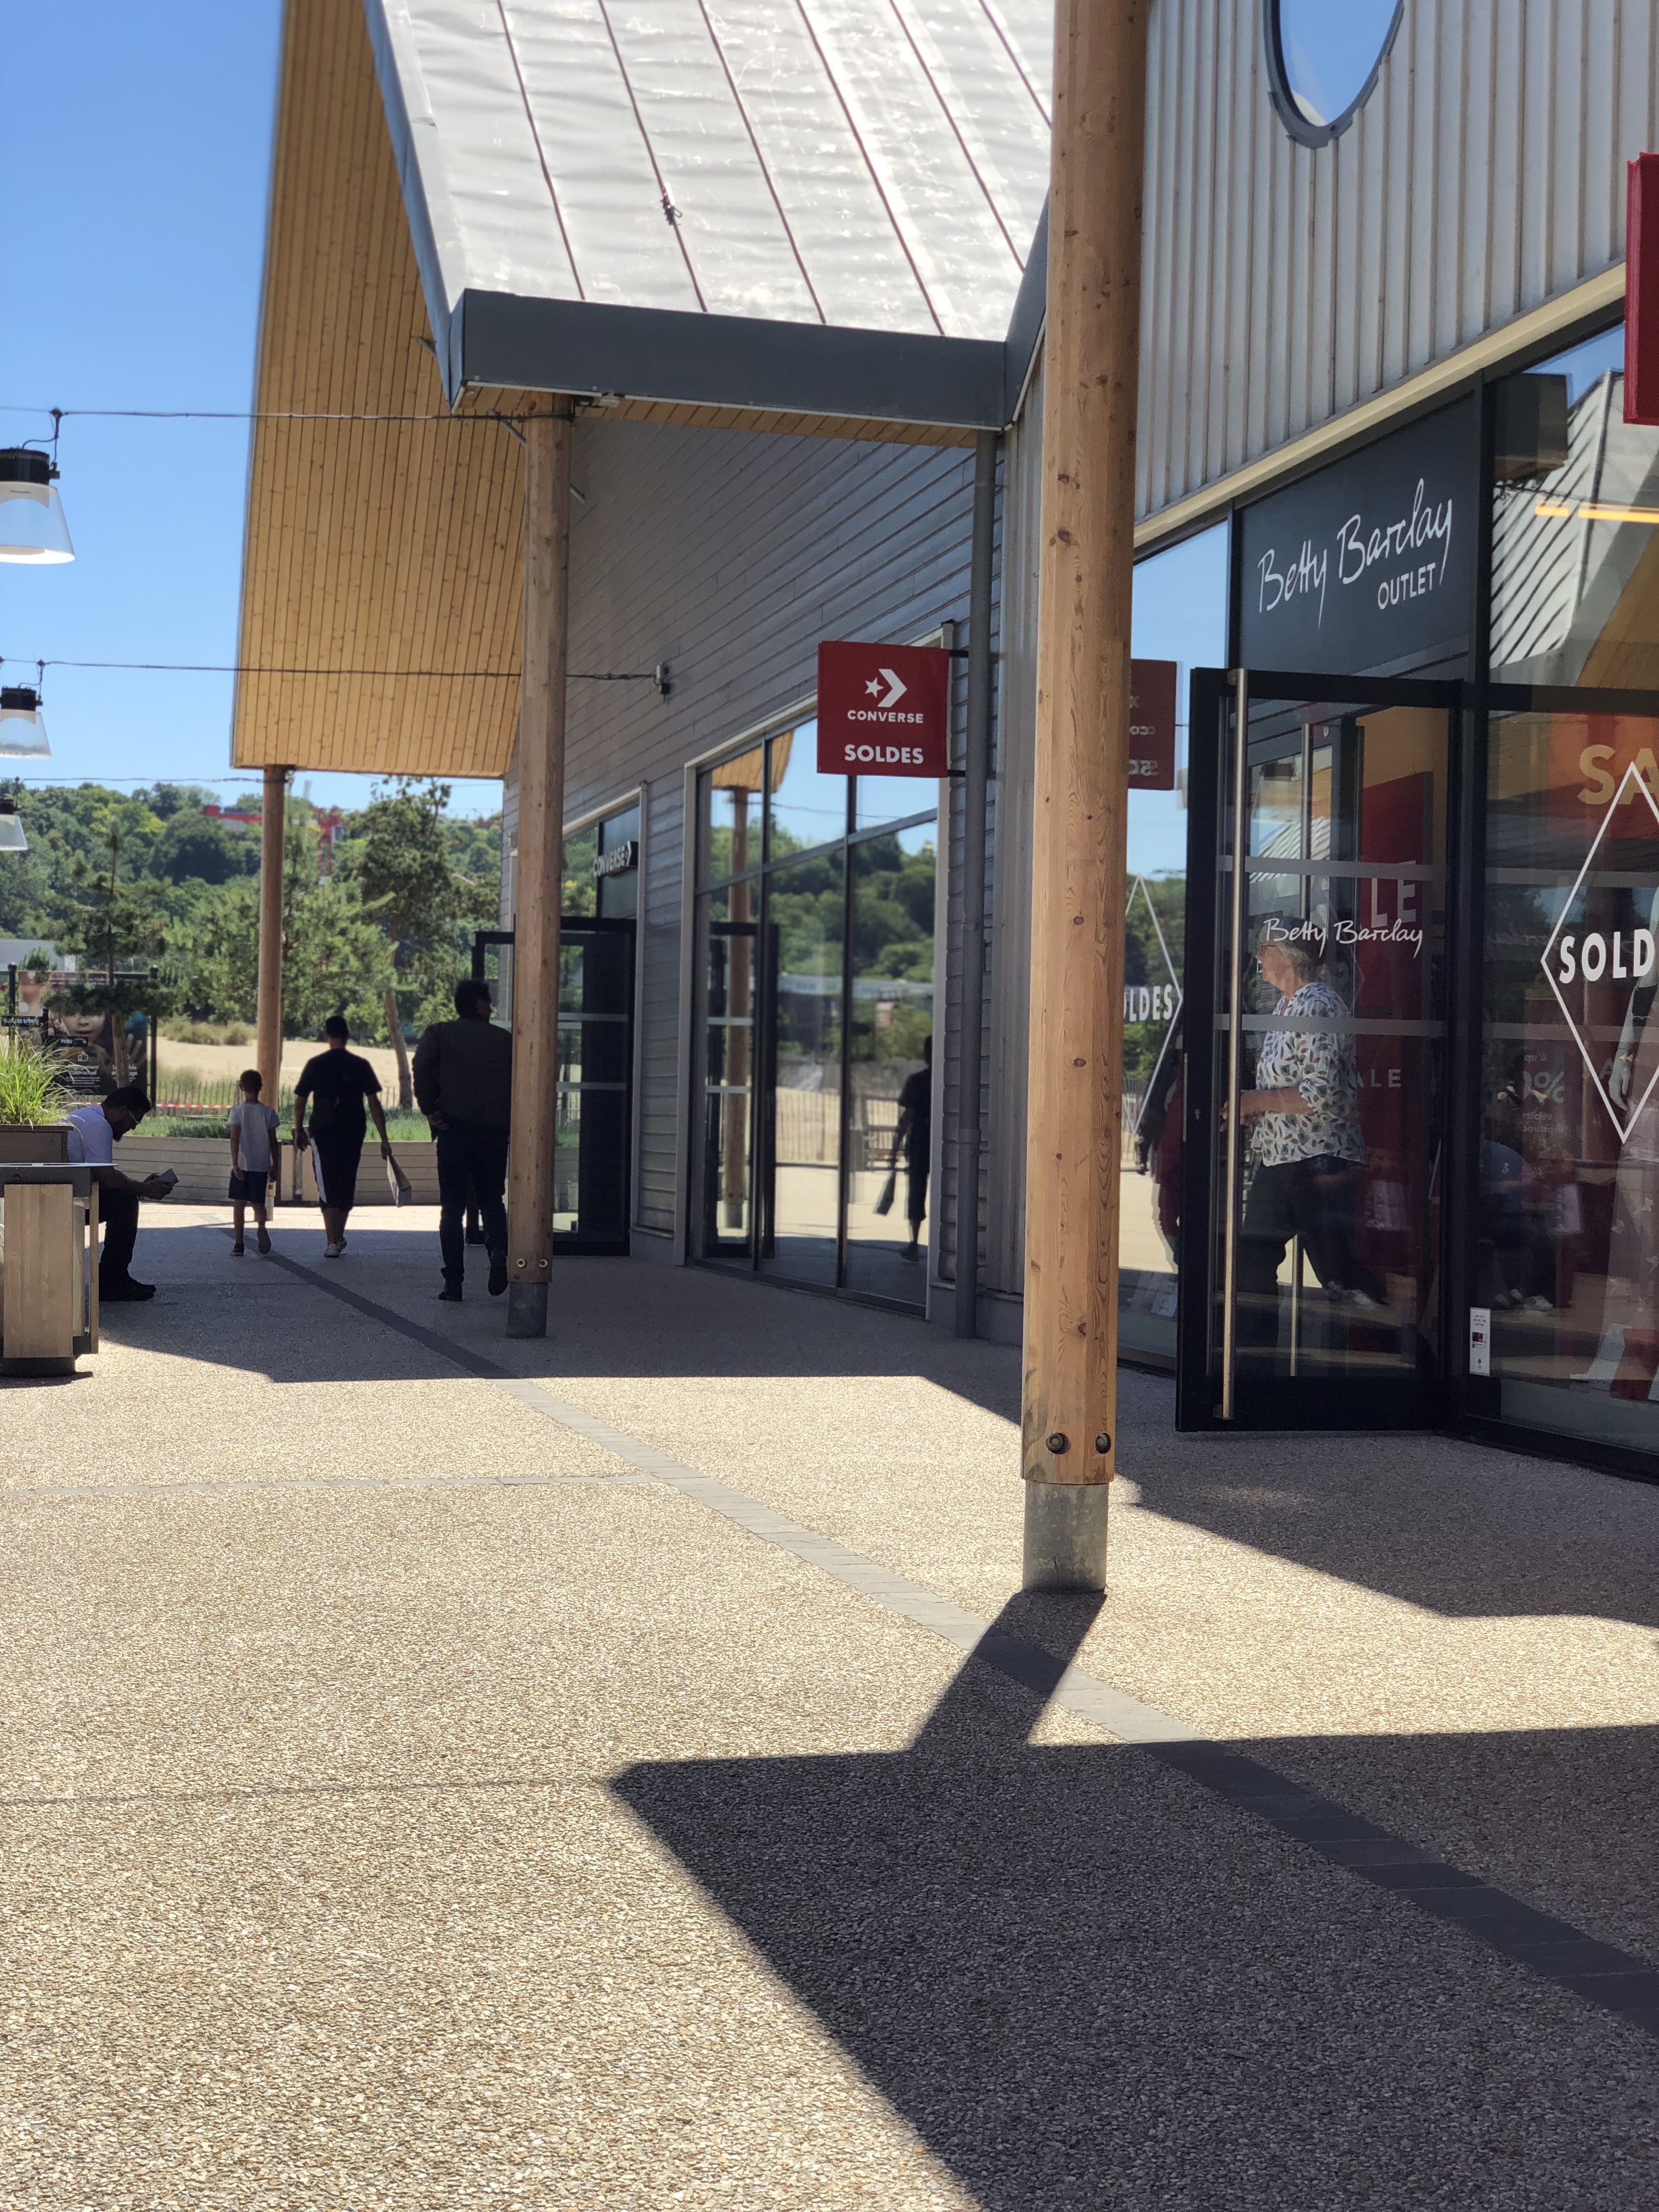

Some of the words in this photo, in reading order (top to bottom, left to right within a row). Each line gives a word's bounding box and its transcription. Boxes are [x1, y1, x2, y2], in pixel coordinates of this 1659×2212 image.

[1257, 539, 1328, 631] Betty
[1336, 478, 1453, 586] Barclay
[1378, 562, 1436, 610] OUTLET
[847, 709, 924, 724] CONVERSE
[844, 744, 924, 765] SOLDES
[1263, 917, 1327, 958] Betty
[1333, 918, 1423, 959] Barclay
[1559, 928, 1655, 984] SOLD
[1124, 984, 1172, 1022] LDES
